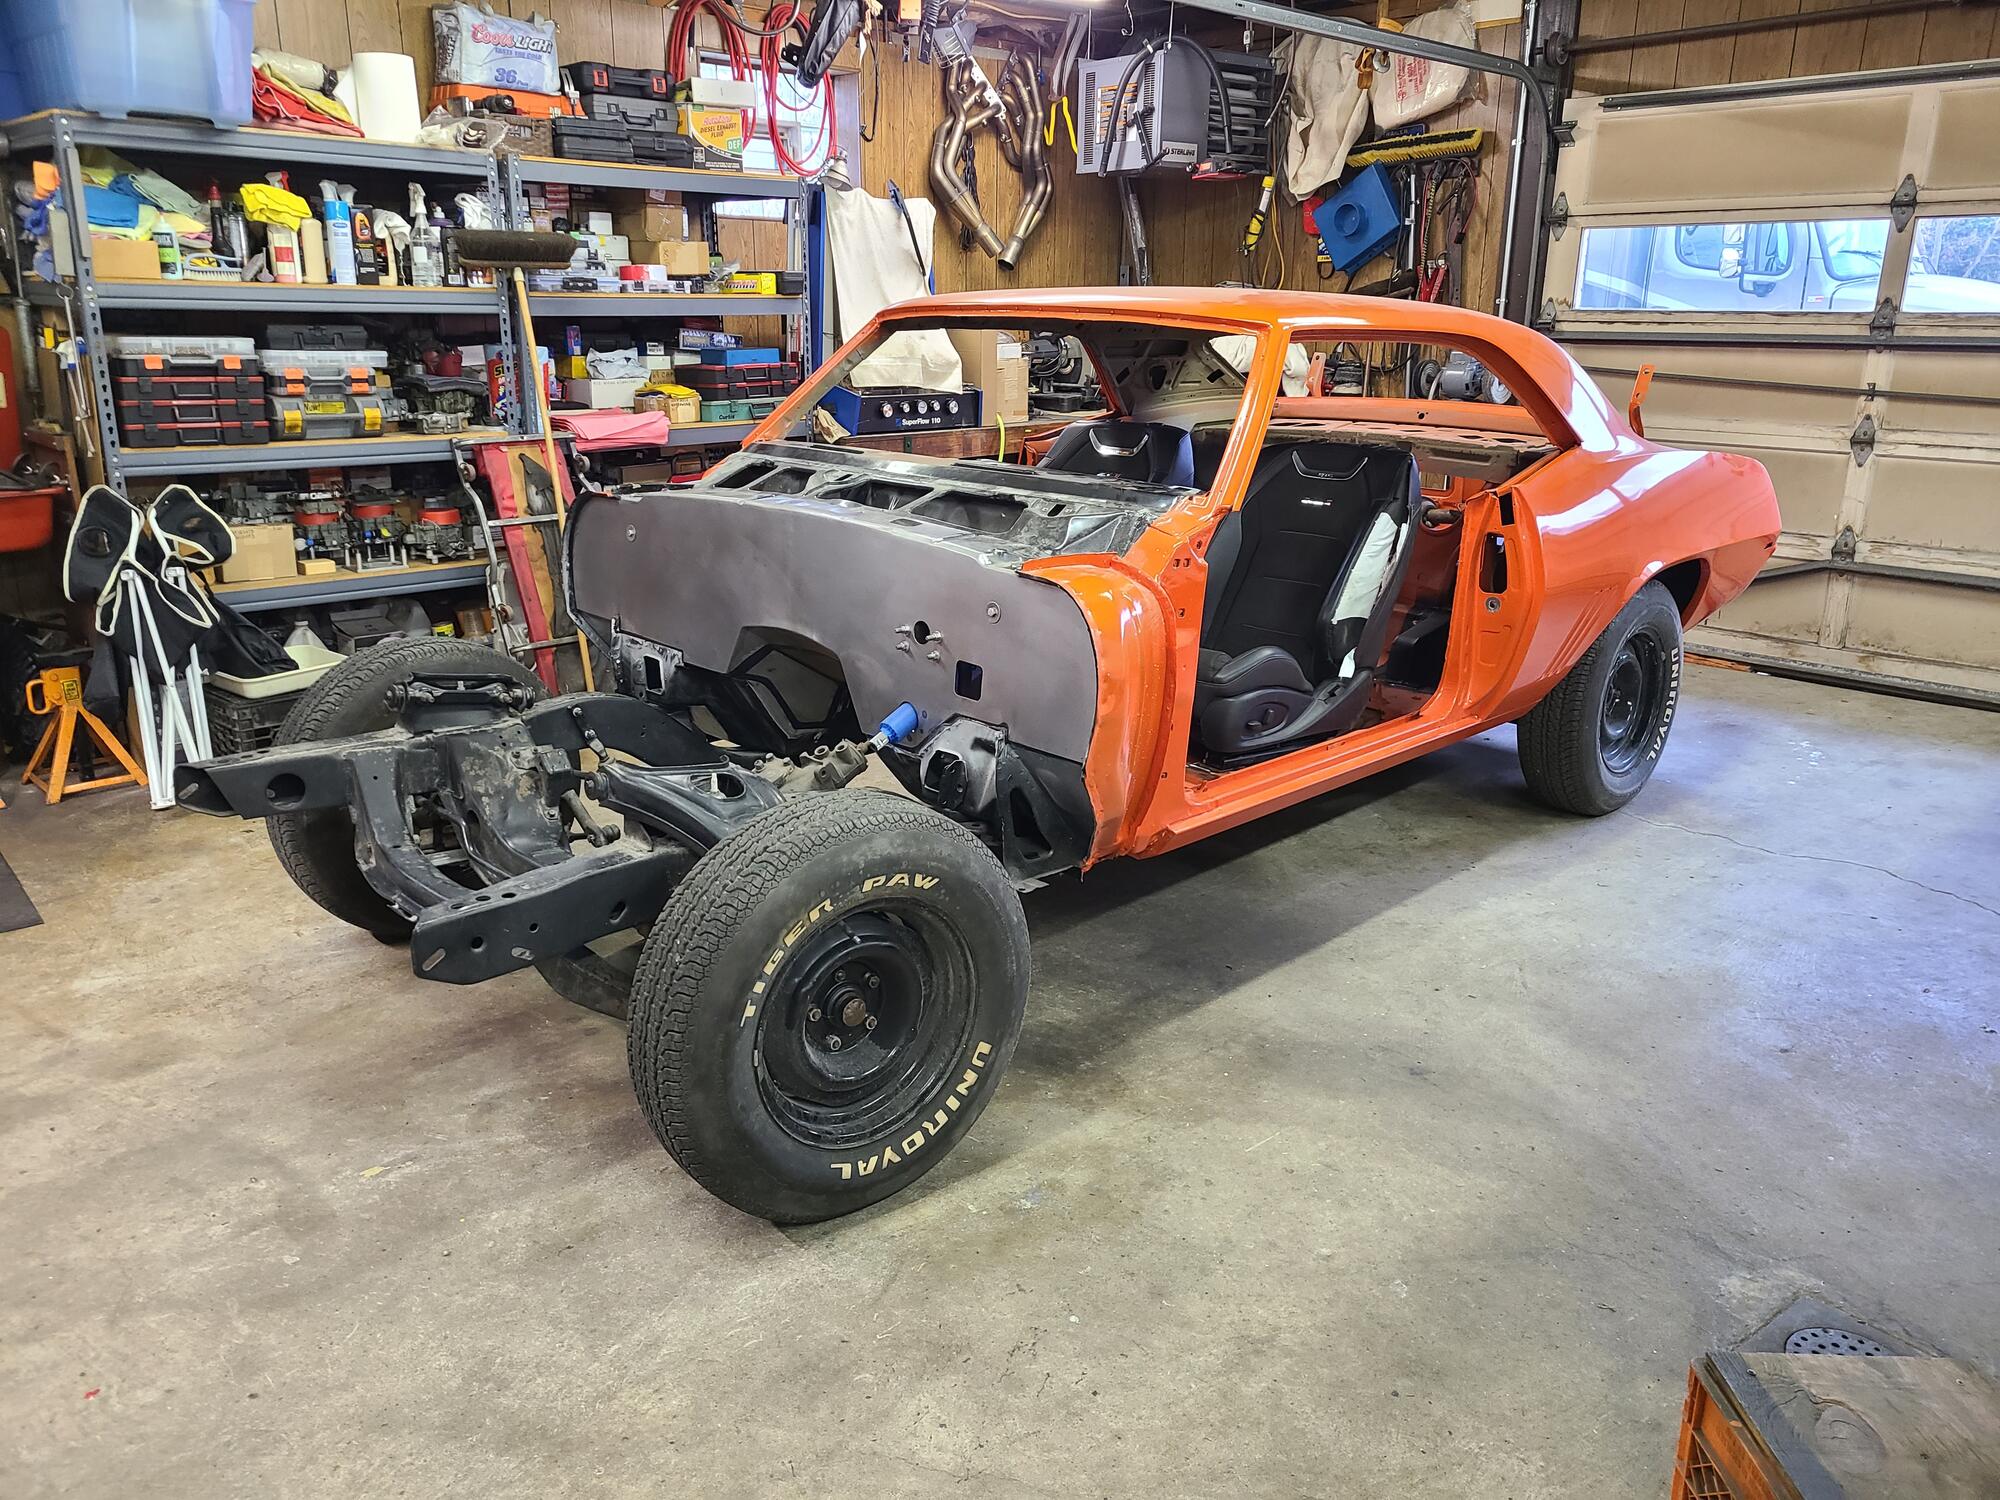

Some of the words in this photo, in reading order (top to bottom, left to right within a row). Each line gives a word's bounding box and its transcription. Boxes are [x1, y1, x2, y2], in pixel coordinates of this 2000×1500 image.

[494, 67, 518, 84] 36
[700, 125, 716, 134] DIESEL
[710, 130, 724, 138] FLUID
[727, 139, 742, 150] DEF
[901, 417, 930, 427] SuperFlow
[931, 416, 941, 425] 110
[1646, 647, 1679, 761] UNIROYAL
[740, 897, 835, 1028] TIGER
[859, 872, 941, 894] PAW
[830, 1040, 993, 1181] UNIROYAL
